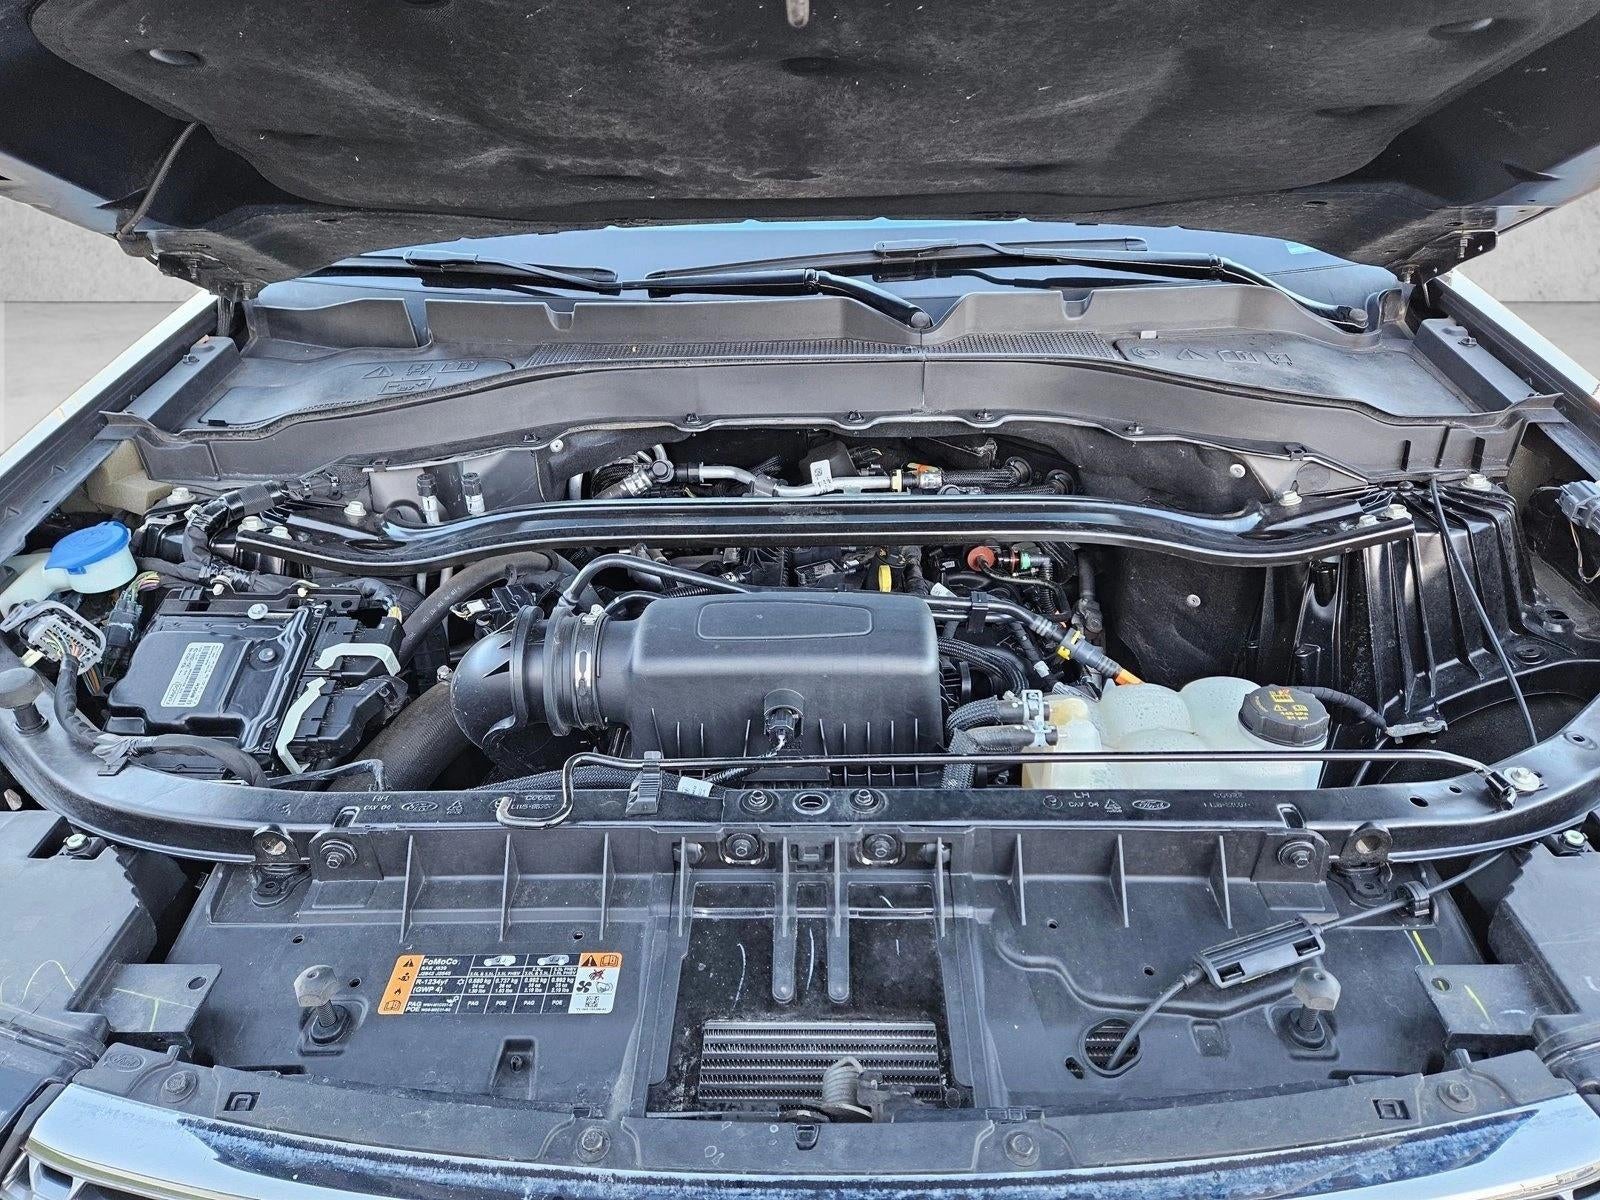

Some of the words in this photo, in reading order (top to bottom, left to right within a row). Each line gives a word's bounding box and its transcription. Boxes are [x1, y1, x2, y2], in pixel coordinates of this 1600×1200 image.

[1073, 791, 1090, 799] LH
[1136, 799, 1167, 810] Ford
[422, 958, 458, 966] FoMoCo
[415, 979, 449, 987] R-1234yf
[540, 977, 548, 985] kg
[412, 986, 434, 994] (GWP
[435, 986, 443, 994] 4)
